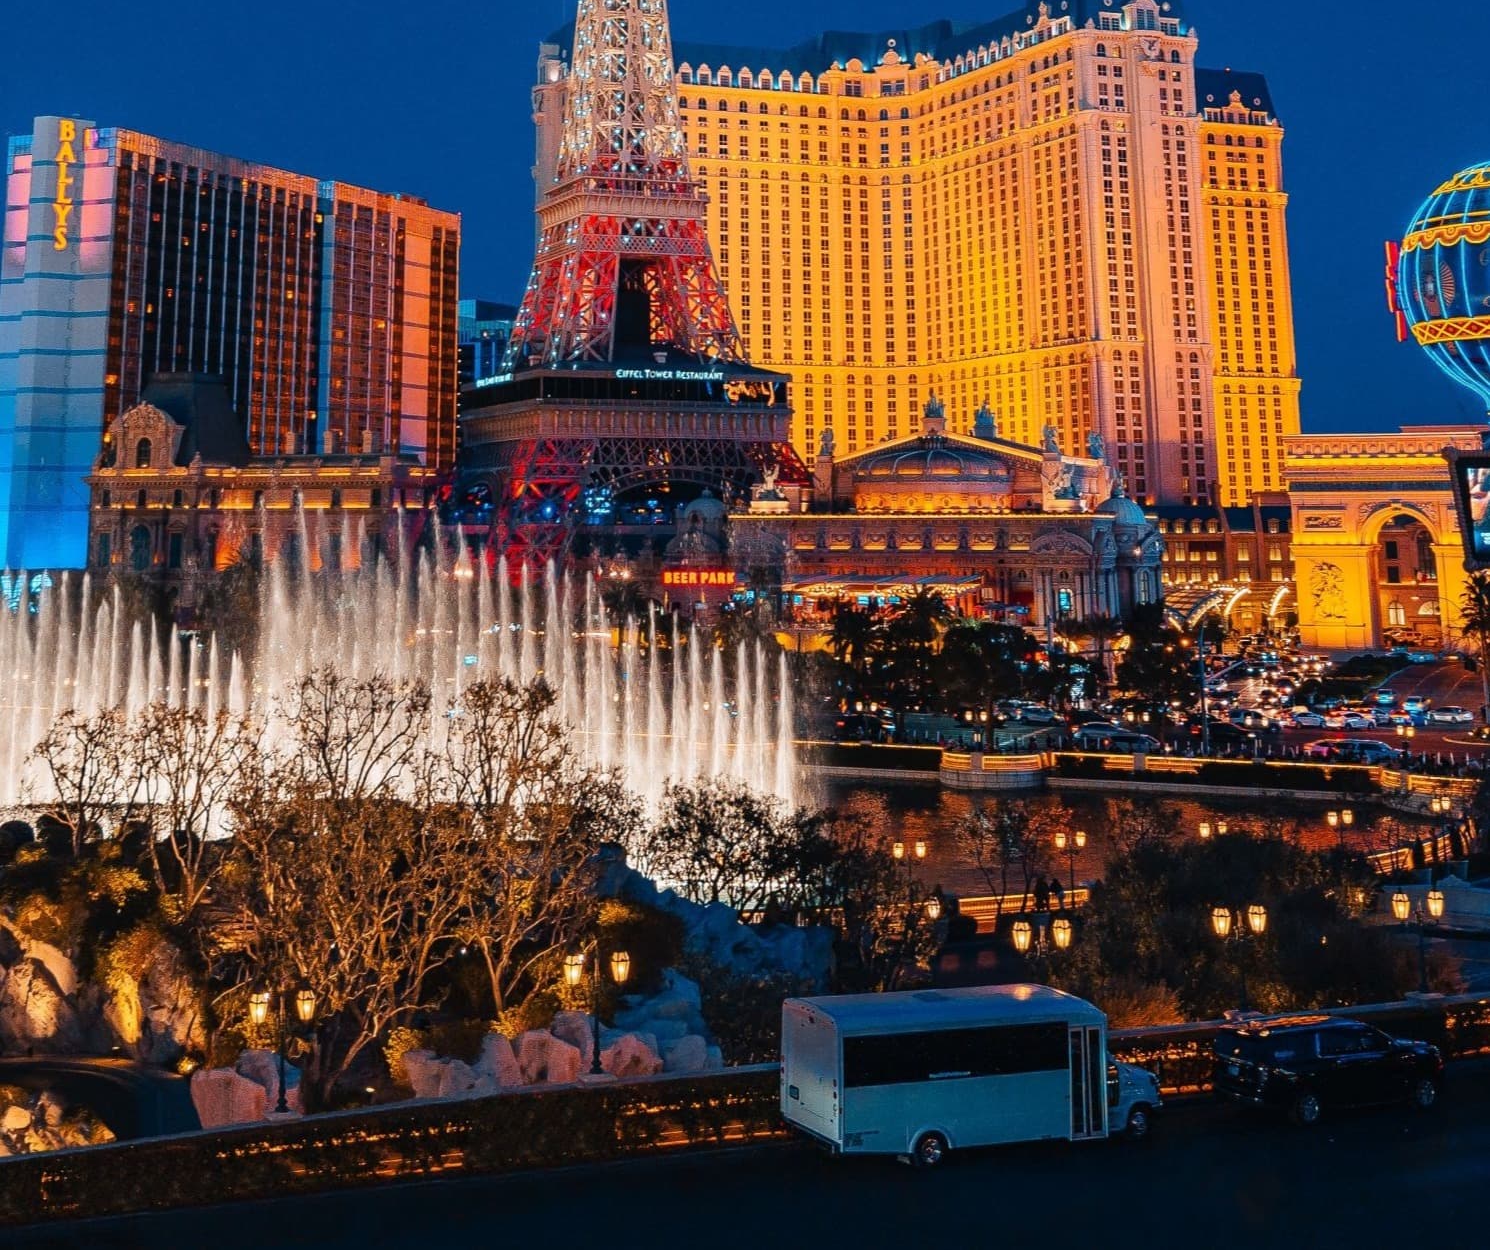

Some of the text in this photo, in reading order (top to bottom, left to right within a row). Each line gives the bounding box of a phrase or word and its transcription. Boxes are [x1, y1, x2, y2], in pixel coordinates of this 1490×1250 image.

[644, 369, 673, 379] TOWER
[664, 572, 735, 584] BEER PARK
